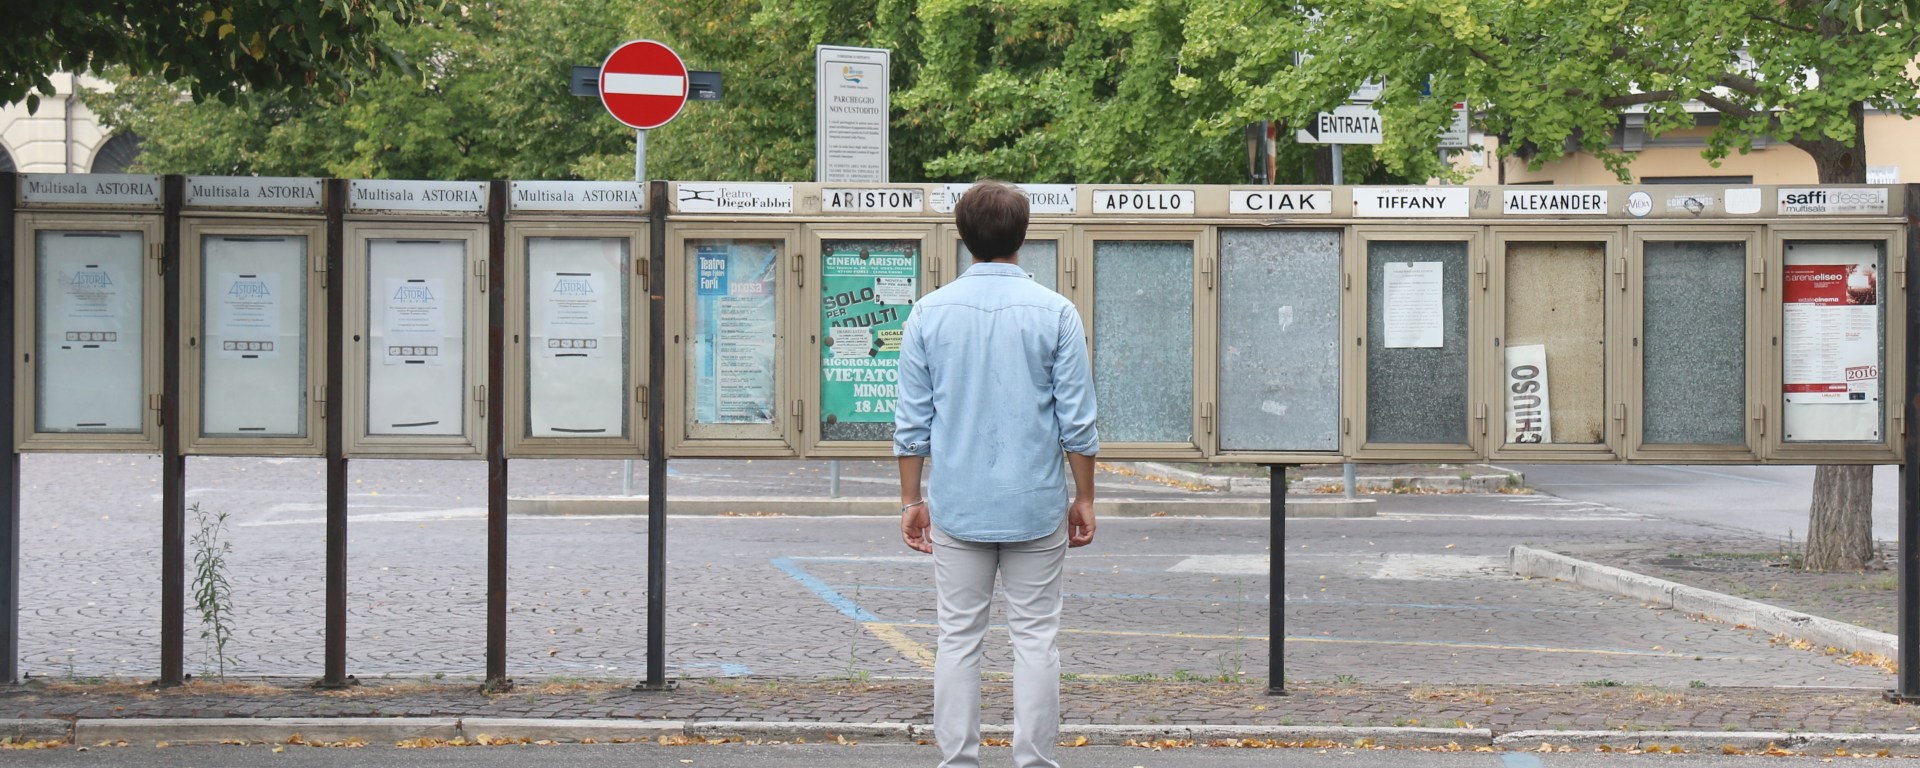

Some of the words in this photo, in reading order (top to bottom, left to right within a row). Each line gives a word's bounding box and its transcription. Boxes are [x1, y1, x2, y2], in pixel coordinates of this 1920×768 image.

[834, 95, 875, 105] PARCHEGGIO
[844, 106, 879, 115] CUSTODITO
[1321, 116, 1379, 134] ENTRATA
[29, 181, 87, 195] Multisala
[96, 182, 154, 195] ASTORIA
[192, 185, 250, 198] Multisala
[258, 186, 315, 199] ASTORIA
[357, 188, 414, 201] Multisala
[422, 189, 478, 202] ASTORIA
[718, 187, 752, 198] Teatro
[518, 189, 574, 202] Multisala
[582, 189, 638, 202] ASTORIA
[831, 192, 913, 208] ARISTON
[1029, 192, 1070, 205] TORIA
[1106, 193, 1181, 210] APOLLO
[1246, 193, 1316, 211] CIAK
[1376, 196, 1446, 209] TIFFANY
[1509, 194, 1602, 210] ALEXANDER
[1786, 191, 1826, 204] saffi
[1786, 204, 1826, 212] multisala
[700, 257, 725, 270] Teatro
[826, 257, 867, 266] CINEMA
[869, 257, 912, 266] ARISTON
[731, 281, 763, 296] prosa
[823, 287, 875, 310] SOLO
[826, 308, 847, 319] PER
[831, 307, 898, 328] ADULTI
[823, 358, 899, 367] RIGOROSAMEN
[823, 367, 899, 382] VIETATO
[1848, 365, 1878, 380] 2016
[855, 400, 871, 413] 18
[874, 400, 896, 413] AN
[1511, 364, 1542, 443] CHIUSO
